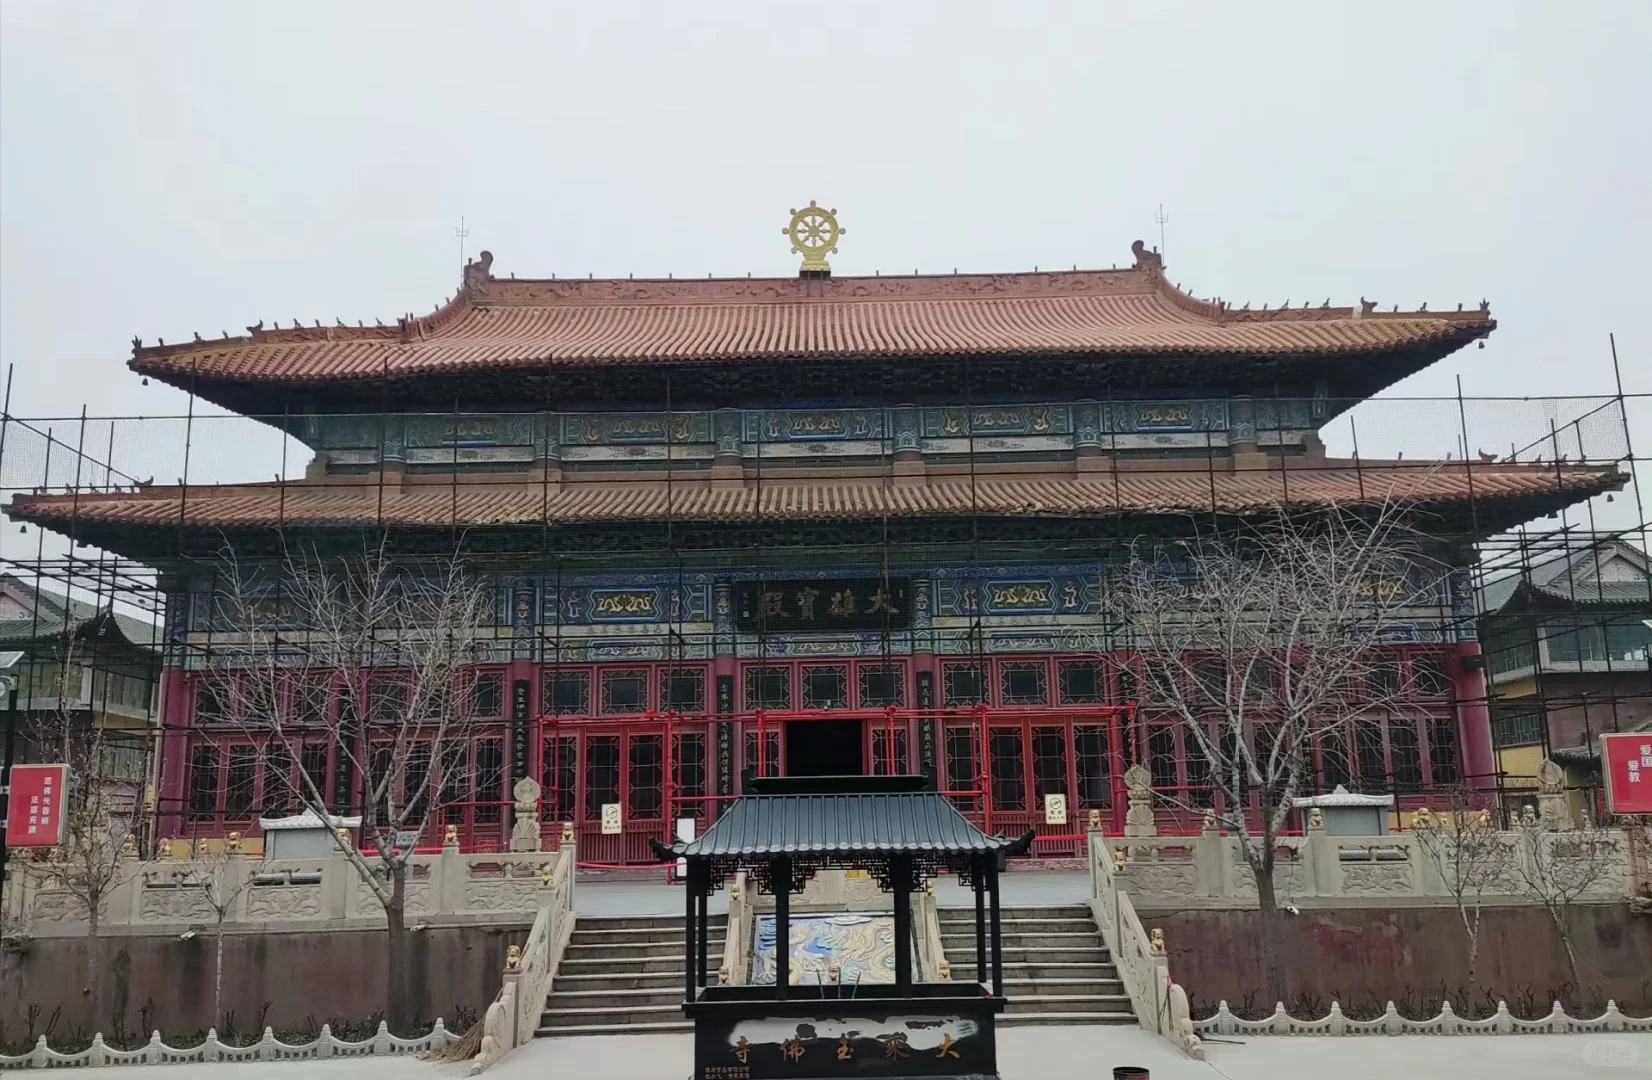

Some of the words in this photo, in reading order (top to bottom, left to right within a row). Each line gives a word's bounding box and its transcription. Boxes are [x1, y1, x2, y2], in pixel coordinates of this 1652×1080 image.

[1640, 745, 1652, 767] 爱国
[1627, 760, 1641, 783] 爱教
[28, 795, 39, 834] 法喜充满
